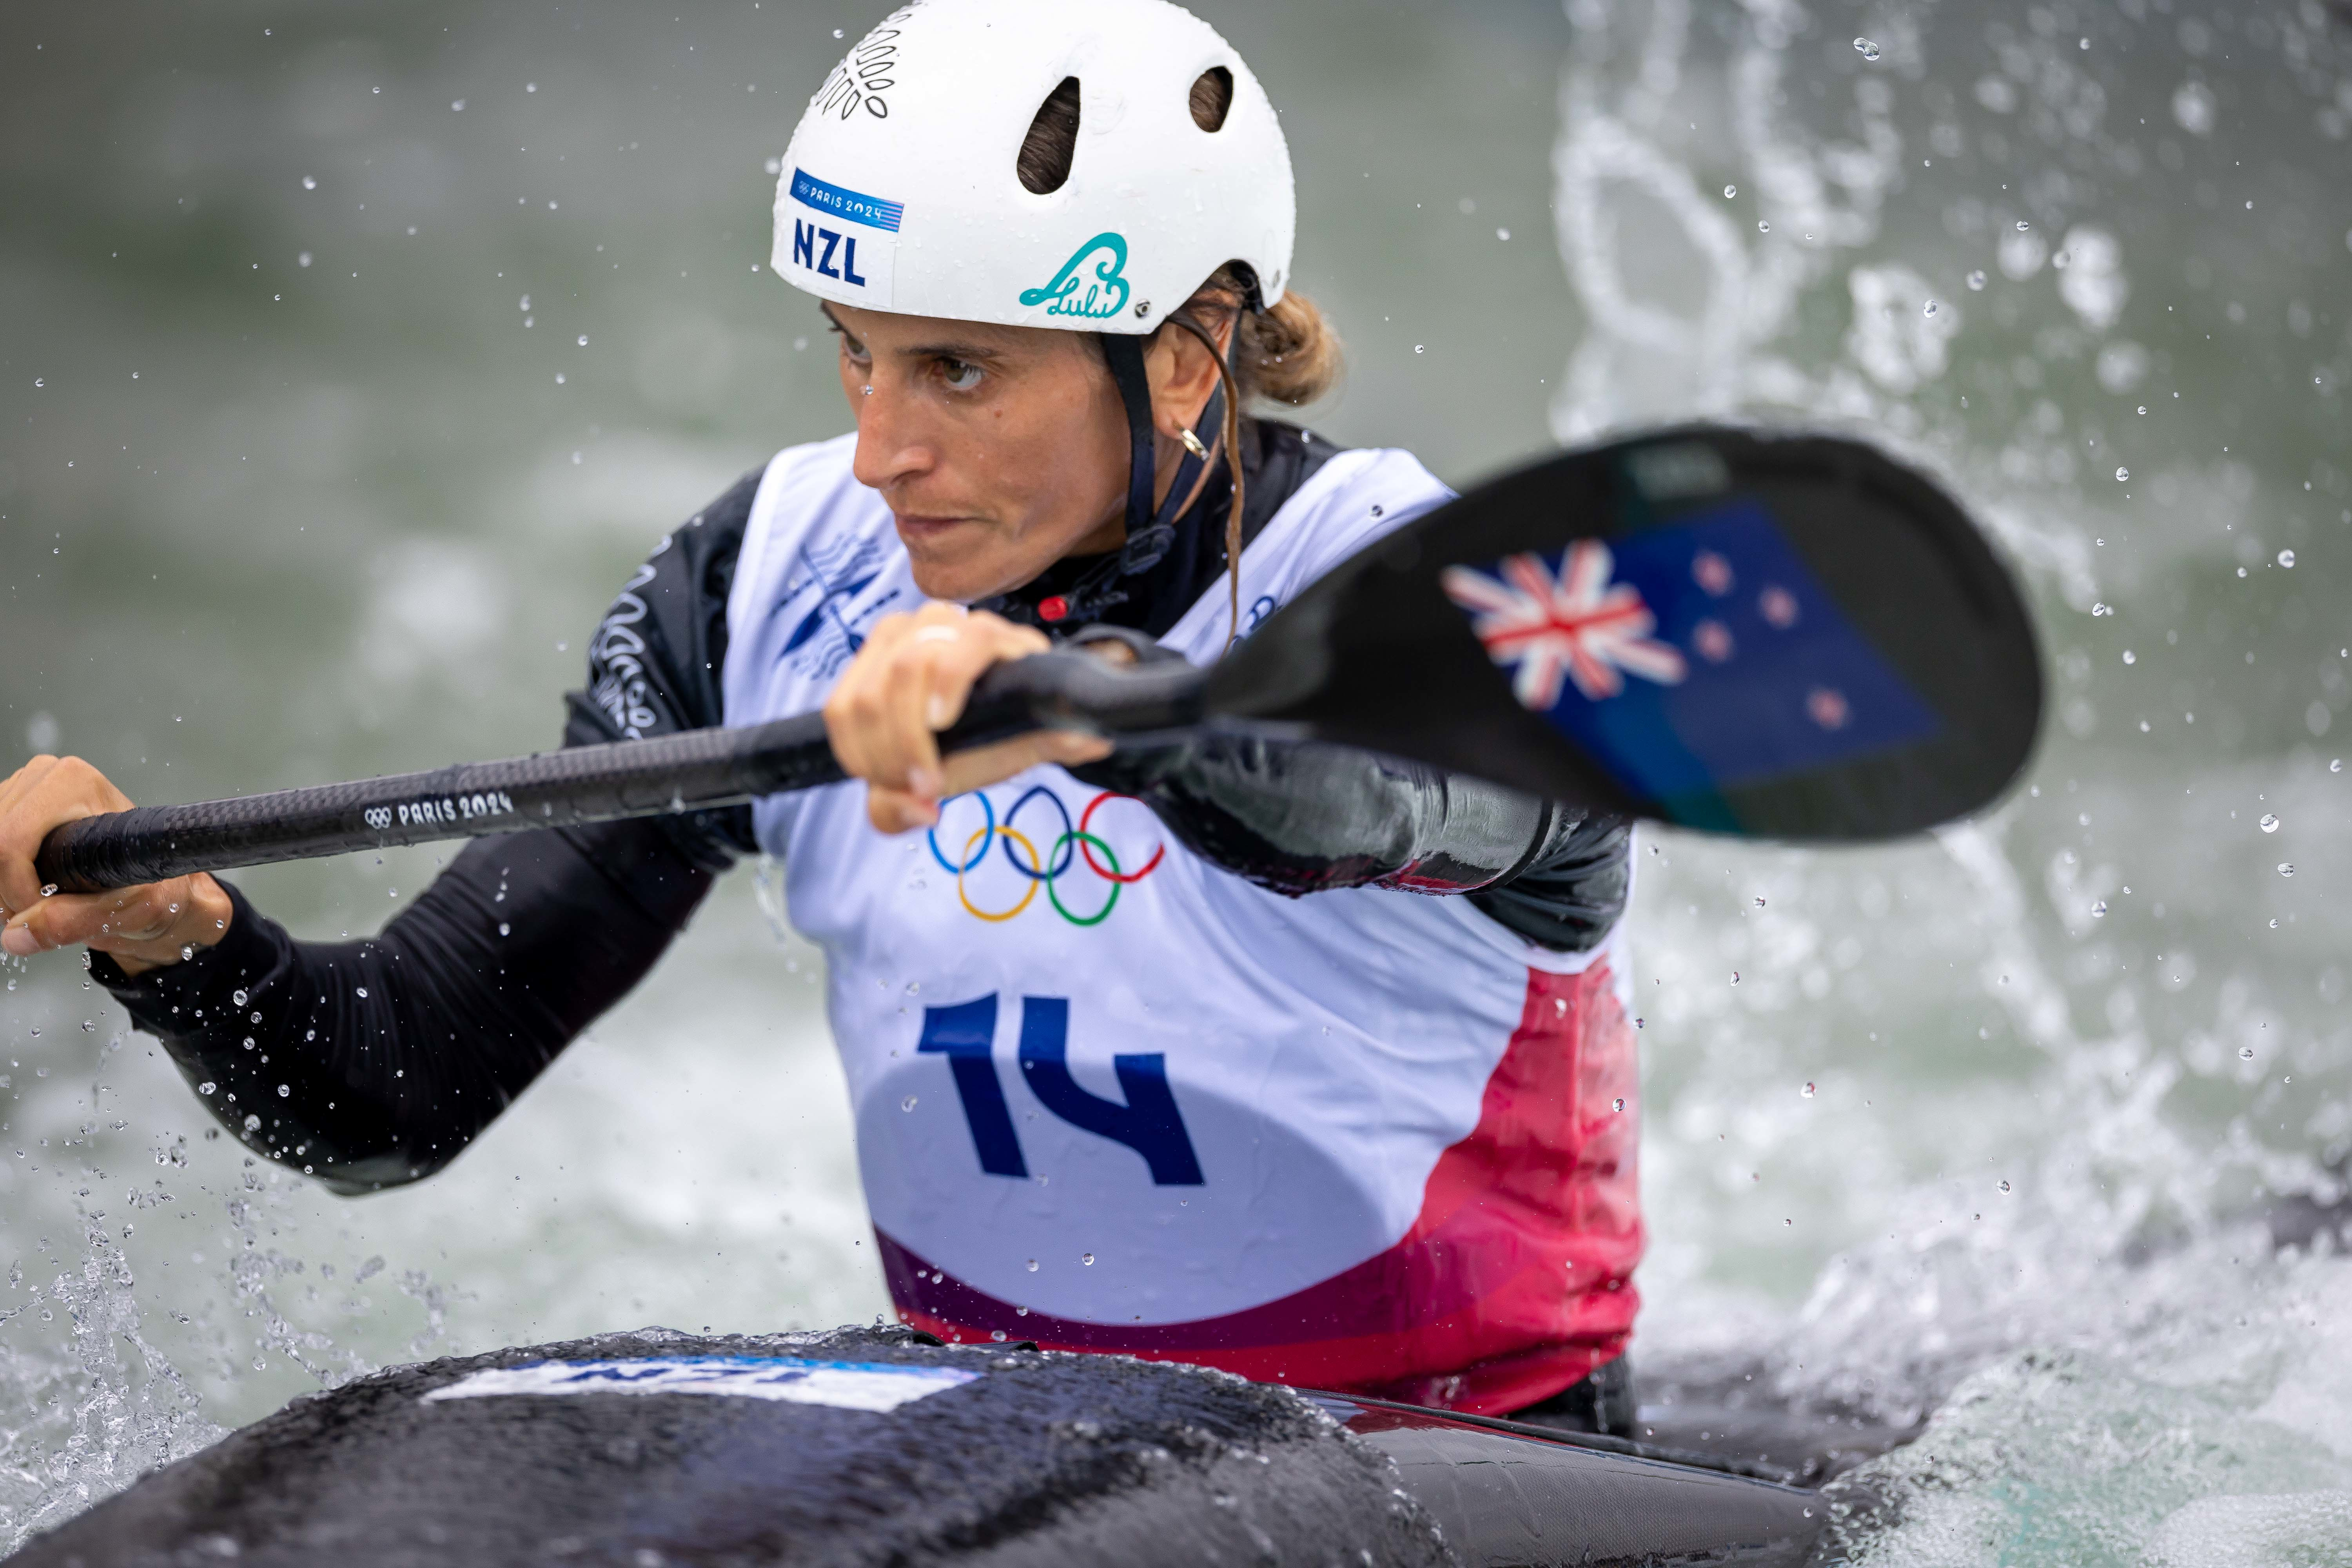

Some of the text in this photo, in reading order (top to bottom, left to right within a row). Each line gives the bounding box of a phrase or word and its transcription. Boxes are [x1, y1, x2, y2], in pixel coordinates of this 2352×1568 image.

[810, 187, 882, 220] PARIS 2024
[794, 217, 866, 287] NZL
[398, 791, 514, 826] PARIS 2024
[916, 990, 1205, 1187] 14
